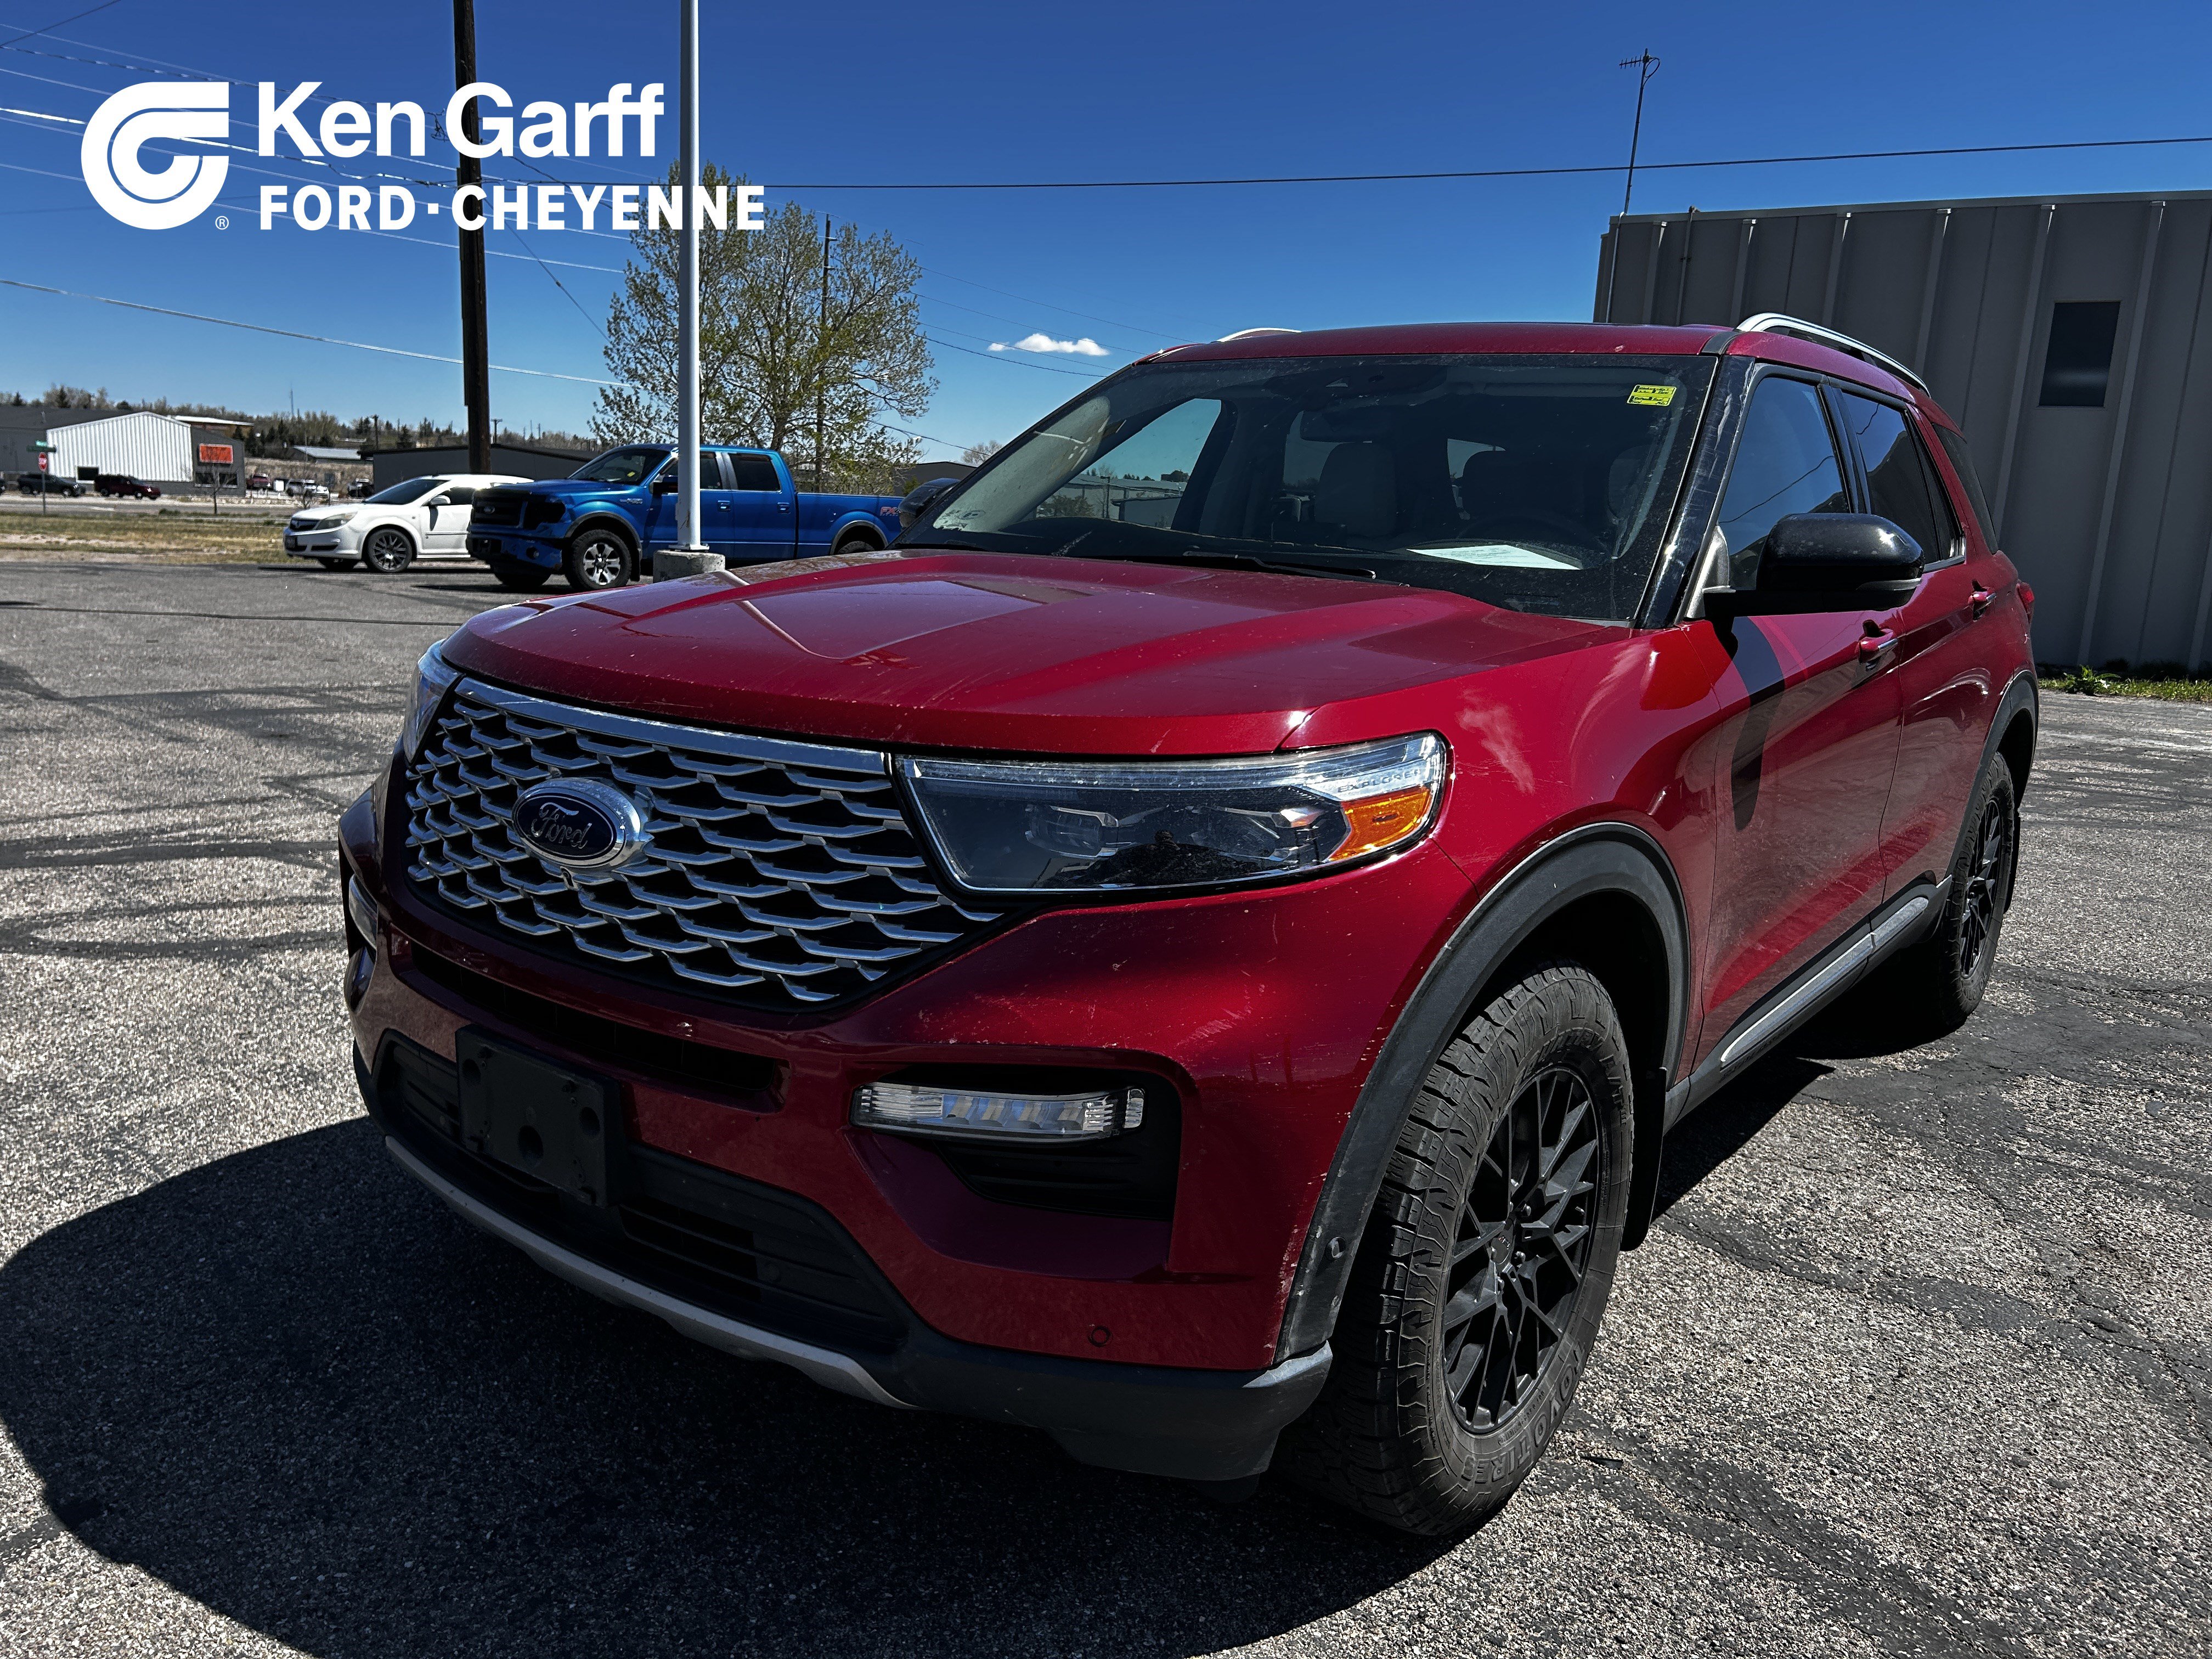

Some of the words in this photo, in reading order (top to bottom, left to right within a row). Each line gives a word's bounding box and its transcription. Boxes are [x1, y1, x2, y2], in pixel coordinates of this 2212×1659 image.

[1338, 769, 1421, 793] EXPLORER
[531, 802, 592, 849] Ford
[1534, 1340, 1587, 1448] TOYO
[1461, 1436, 1532, 1485] TIRES
